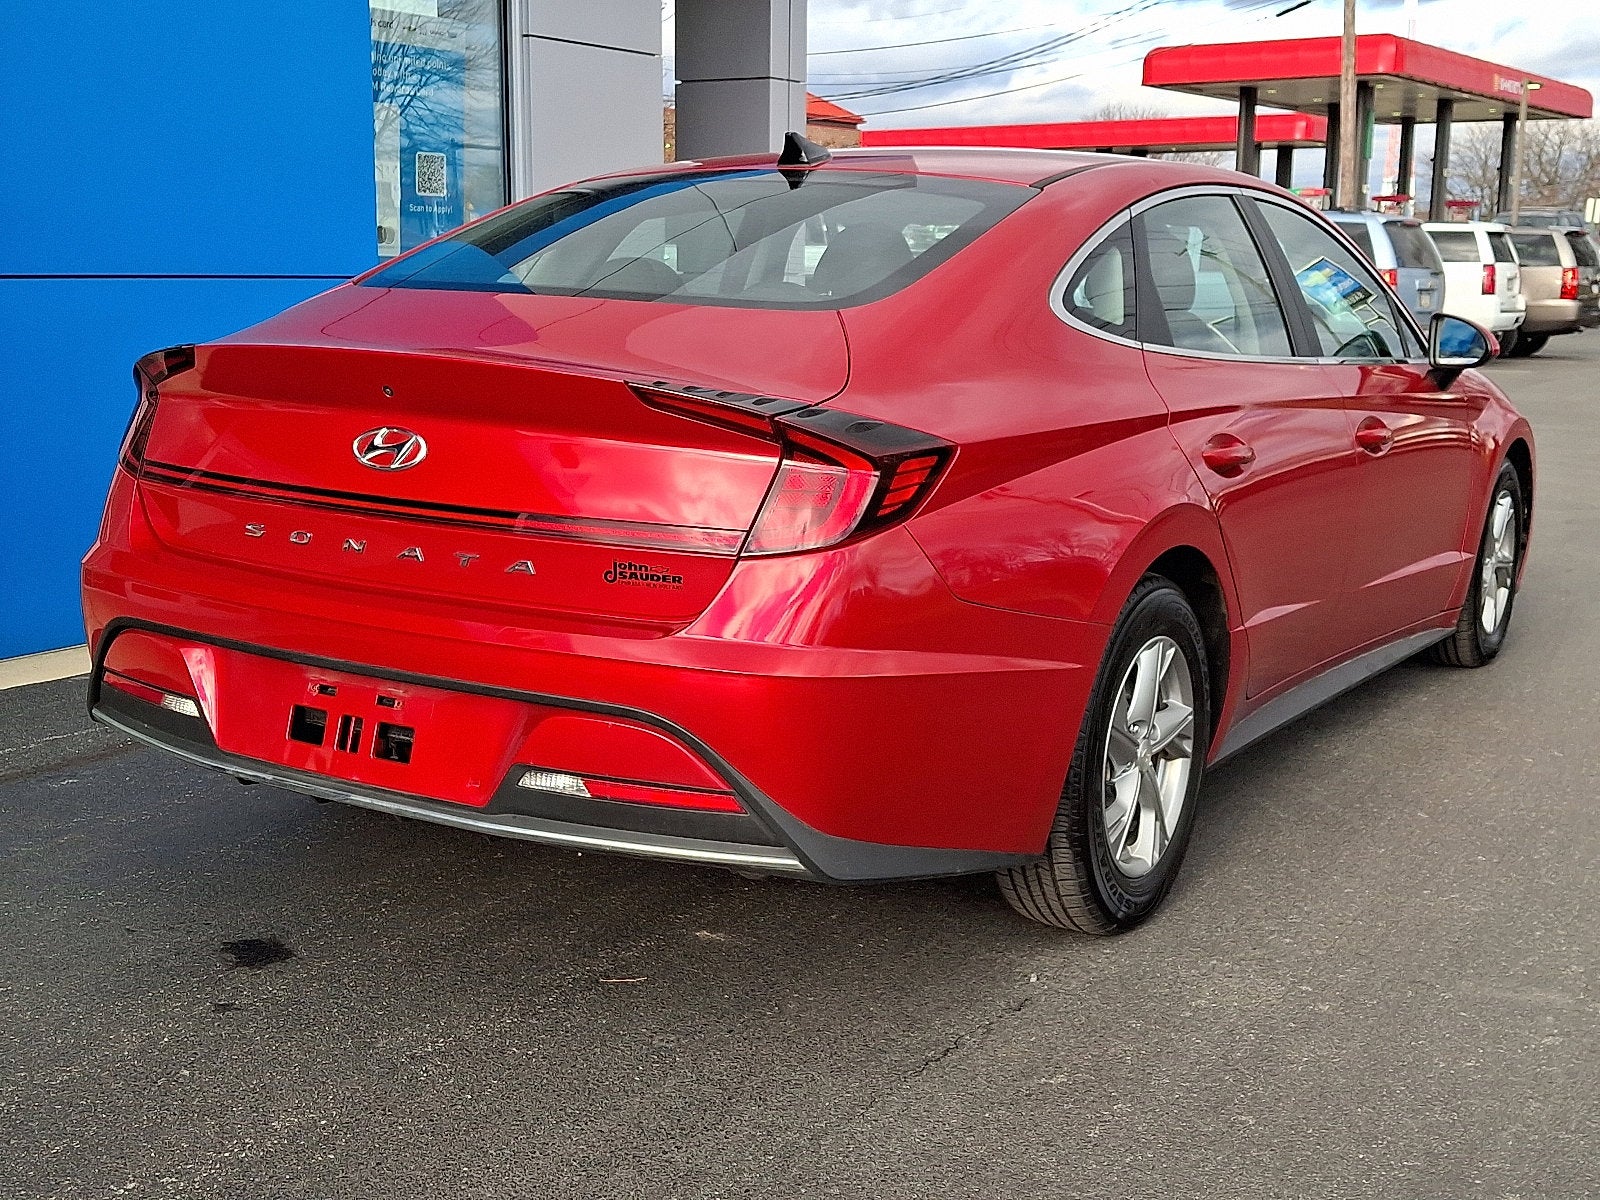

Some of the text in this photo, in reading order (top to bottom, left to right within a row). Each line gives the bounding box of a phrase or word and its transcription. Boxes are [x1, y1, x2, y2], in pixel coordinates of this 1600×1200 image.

[409, 203, 424, 212] Scan
[425, 204, 433, 213] to
[244, 523, 536, 575] SONATA
[618, 570, 684, 585] SAUDER
